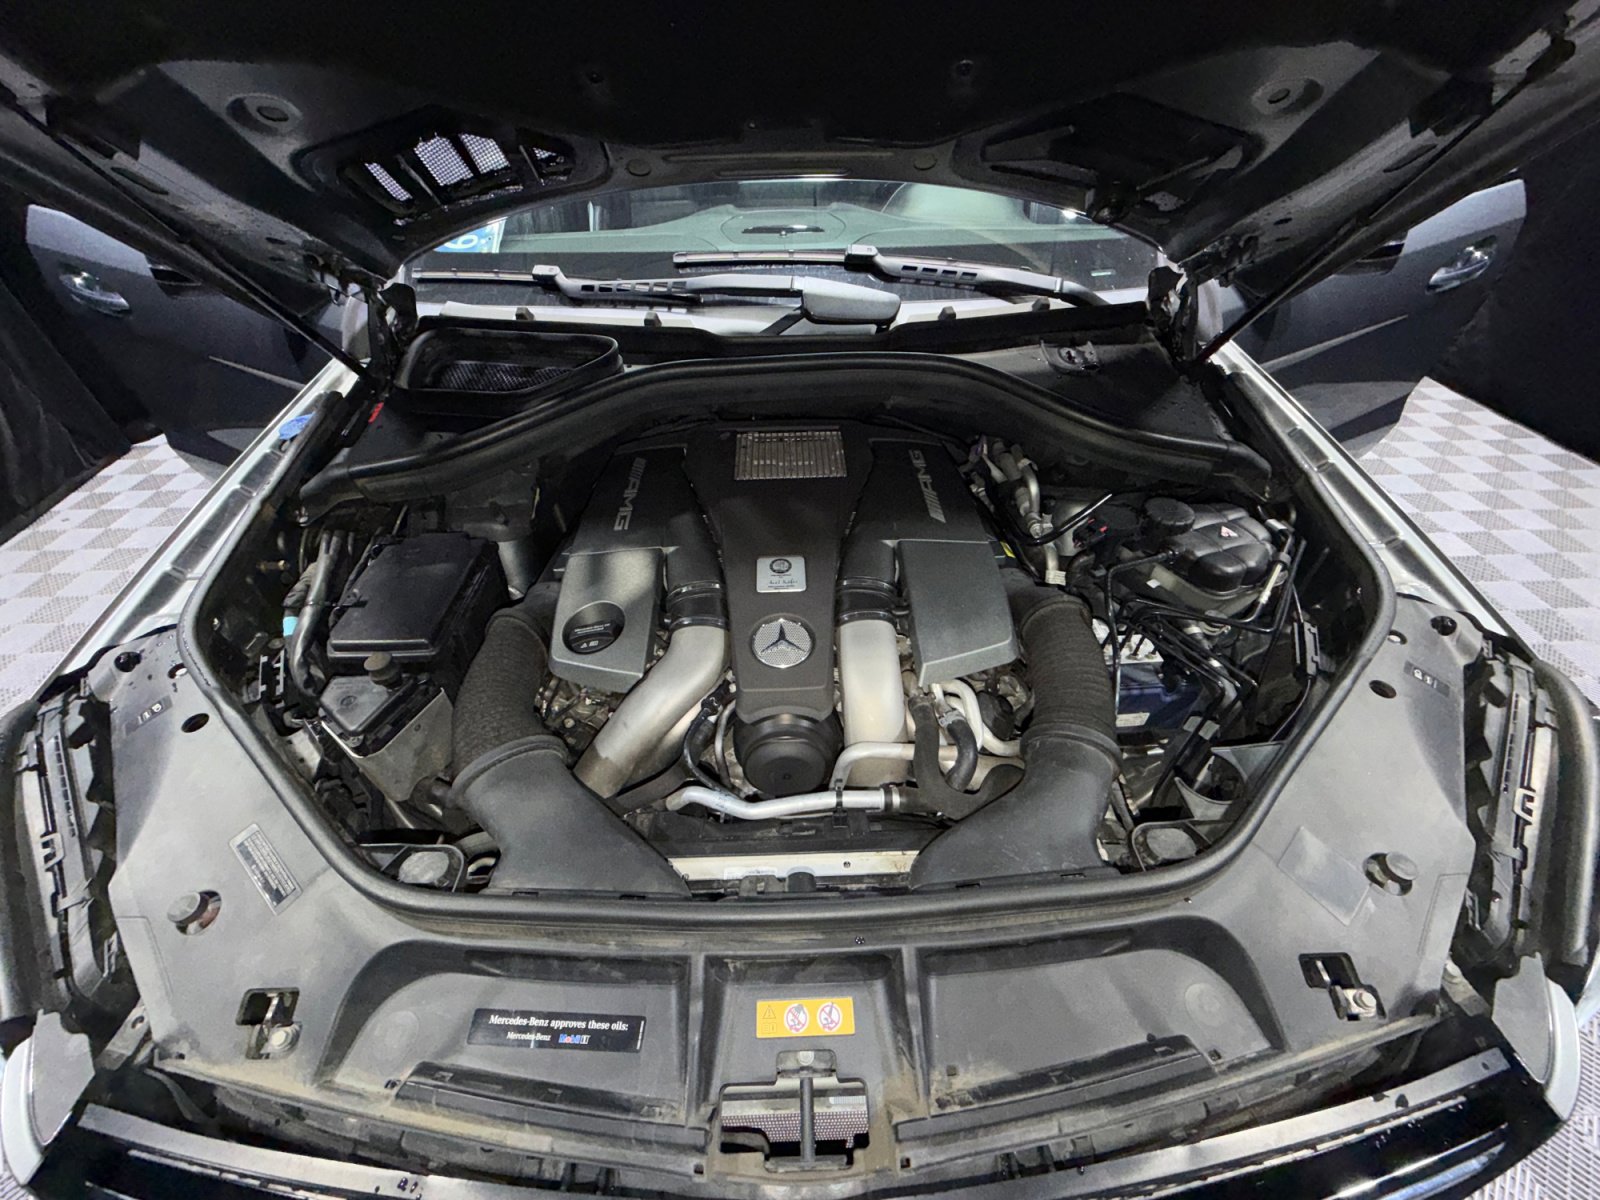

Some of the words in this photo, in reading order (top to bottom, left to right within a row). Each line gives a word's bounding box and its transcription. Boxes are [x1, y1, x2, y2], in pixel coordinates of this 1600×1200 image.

[488, 1014, 549, 1027] Mercedes-Benz
[550, 1019, 586, 1030] approves
[588, 1020, 610, 1030] these
[611, 1021, 629, 1031] oils:
[506, 1031, 552, 1041] Mercedes-Benz
